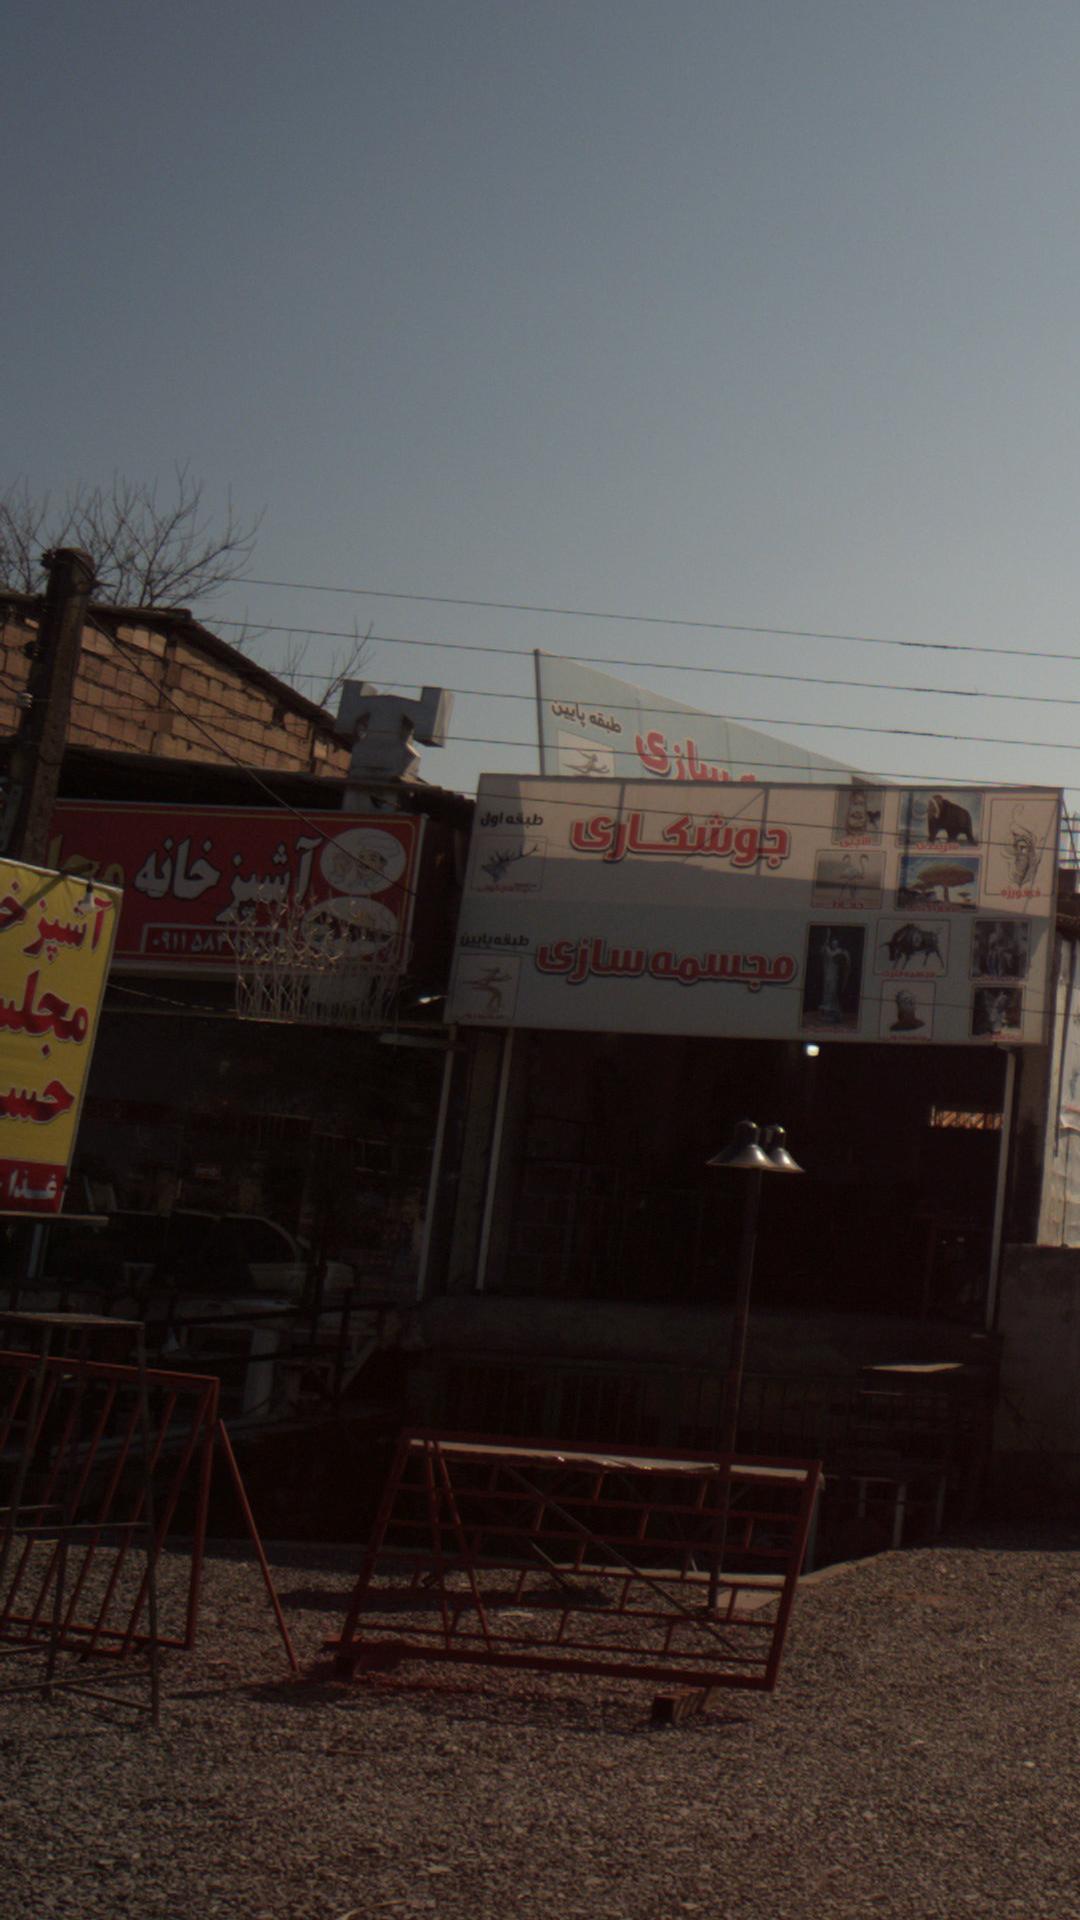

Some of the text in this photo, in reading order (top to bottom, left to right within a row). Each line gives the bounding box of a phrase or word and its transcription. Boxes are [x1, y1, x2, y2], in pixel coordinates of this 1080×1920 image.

[552, 701, 622, 734] طبقه پایین
[480, 812, 544, 827] طبقه اول
[571, 812, 792, 868] جوشکاری
[0, 880, 113, 963] آشپزخ
[460, 933, 530, 948] طبقه پایین
[536, 939, 798, 993] مجسمه سازی
[0, 968, 89, 1056] مجل
[0, 1080, 75, 1124] حس
